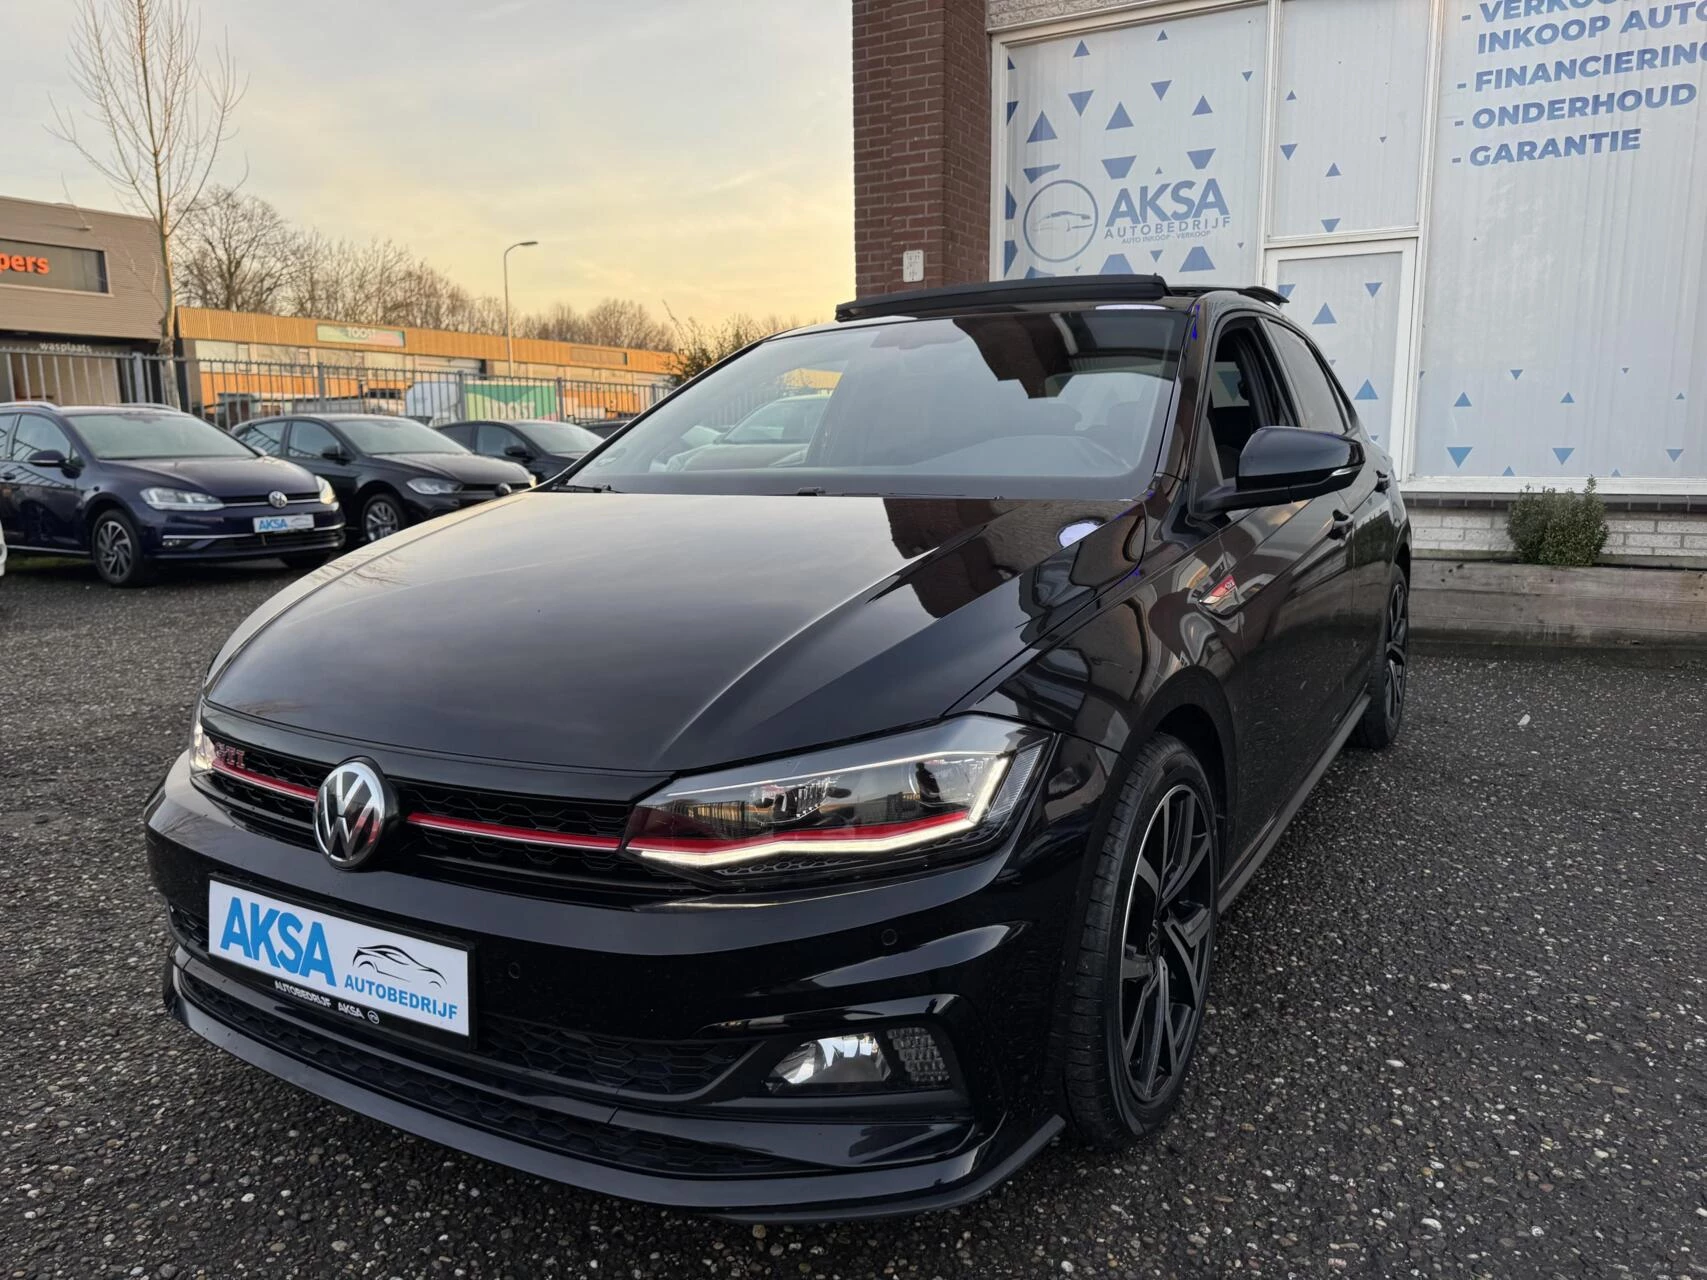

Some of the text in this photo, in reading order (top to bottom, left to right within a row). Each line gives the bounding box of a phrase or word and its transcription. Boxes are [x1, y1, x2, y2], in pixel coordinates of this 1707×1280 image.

[1477, 15, 1611, 54] INKOOP
[1471, 83, 1697, 129] ONDERHOUD
[1469, 128, 1642, 167] GARANTIE
[1105, 178, 1230, 228] AKSA
[1103, 216, 1232, 240] AUTOBEDRIJF
[258, 517, 289, 530] AKSA
[220, 895, 337, 987] AKSA
[274, 980, 366, 1020] AUTOBEDRIJF AKSA
[344, 973, 458, 1020] AUTOBEDRIJF
